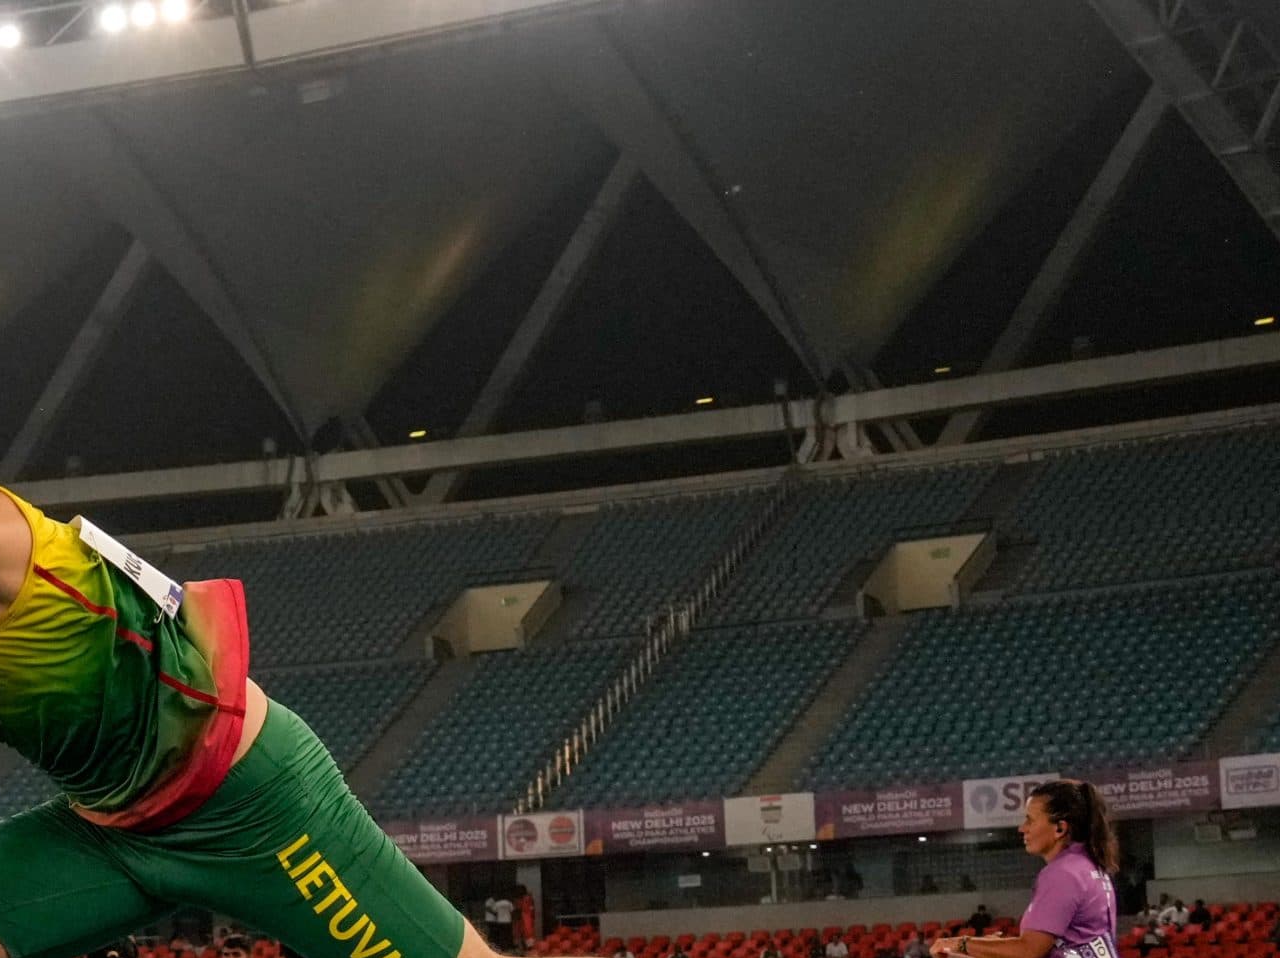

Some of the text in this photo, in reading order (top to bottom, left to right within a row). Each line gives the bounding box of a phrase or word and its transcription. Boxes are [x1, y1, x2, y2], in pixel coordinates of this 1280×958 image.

[1129, 778, 1173, 793] DELHI
[1174, 775, 1209, 788] 2025
[842, 797, 952, 815] NEW DELHI 2025
[611, 815, 715, 831] NEW DELHI 2025
[420, 831, 457, 842] DELHI
[459, 830, 487, 840] 2025
